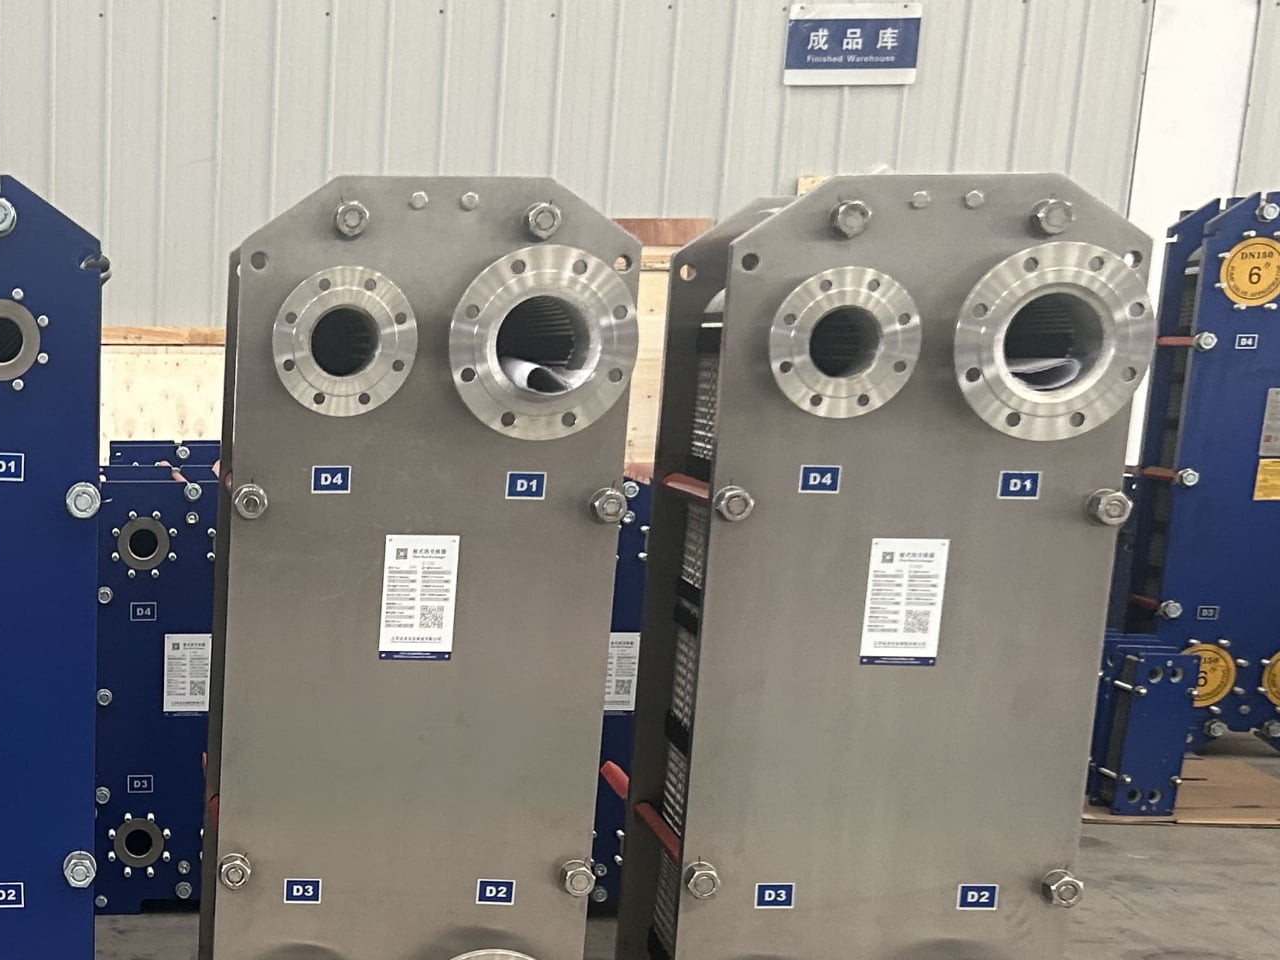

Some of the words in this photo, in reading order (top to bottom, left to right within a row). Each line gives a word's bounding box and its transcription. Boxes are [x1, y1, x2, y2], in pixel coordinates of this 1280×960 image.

[807, 27, 899, 50] 成品库
[806, 55, 844, 63] Finished
[1248, 266, 1262, 285] 6
[1240, 338, 1253, 346] D4
[321, 473, 343, 485] D4
[809, 473, 832, 486] D4
[516, 479, 537, 491] D1
[1010, 479, 1031, 491] D1
[137, 607, 151, 617] D4
[134, 780, 148, 788] D3
[293, 886, 314, 897] D3
[486, 886, 507, 897] D2
[765, 889, 787, 901] D3
[967, 892, 990, 903] D2
